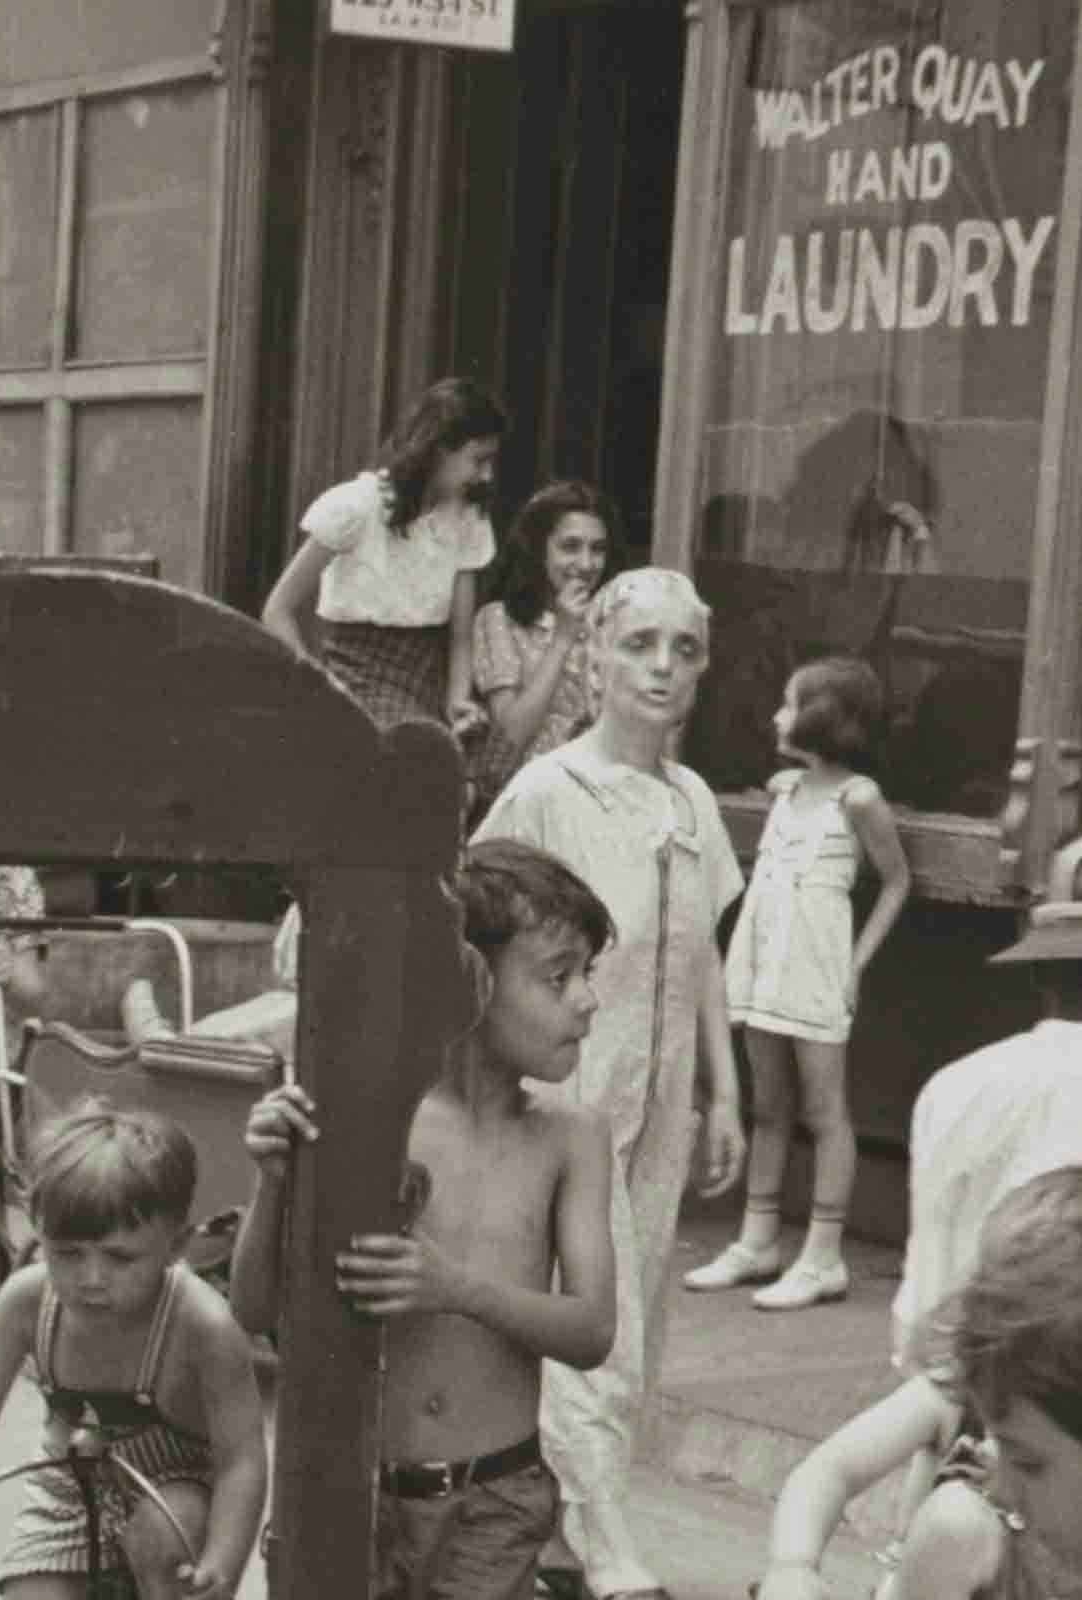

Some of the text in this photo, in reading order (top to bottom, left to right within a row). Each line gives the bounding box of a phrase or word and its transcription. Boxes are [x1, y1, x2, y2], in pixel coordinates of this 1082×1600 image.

[754, 45, 1045, 149] WALTER QUAY
[825, 140, 952, 204] HAND
[724, 216, 1056, 335] LAUNDRY
